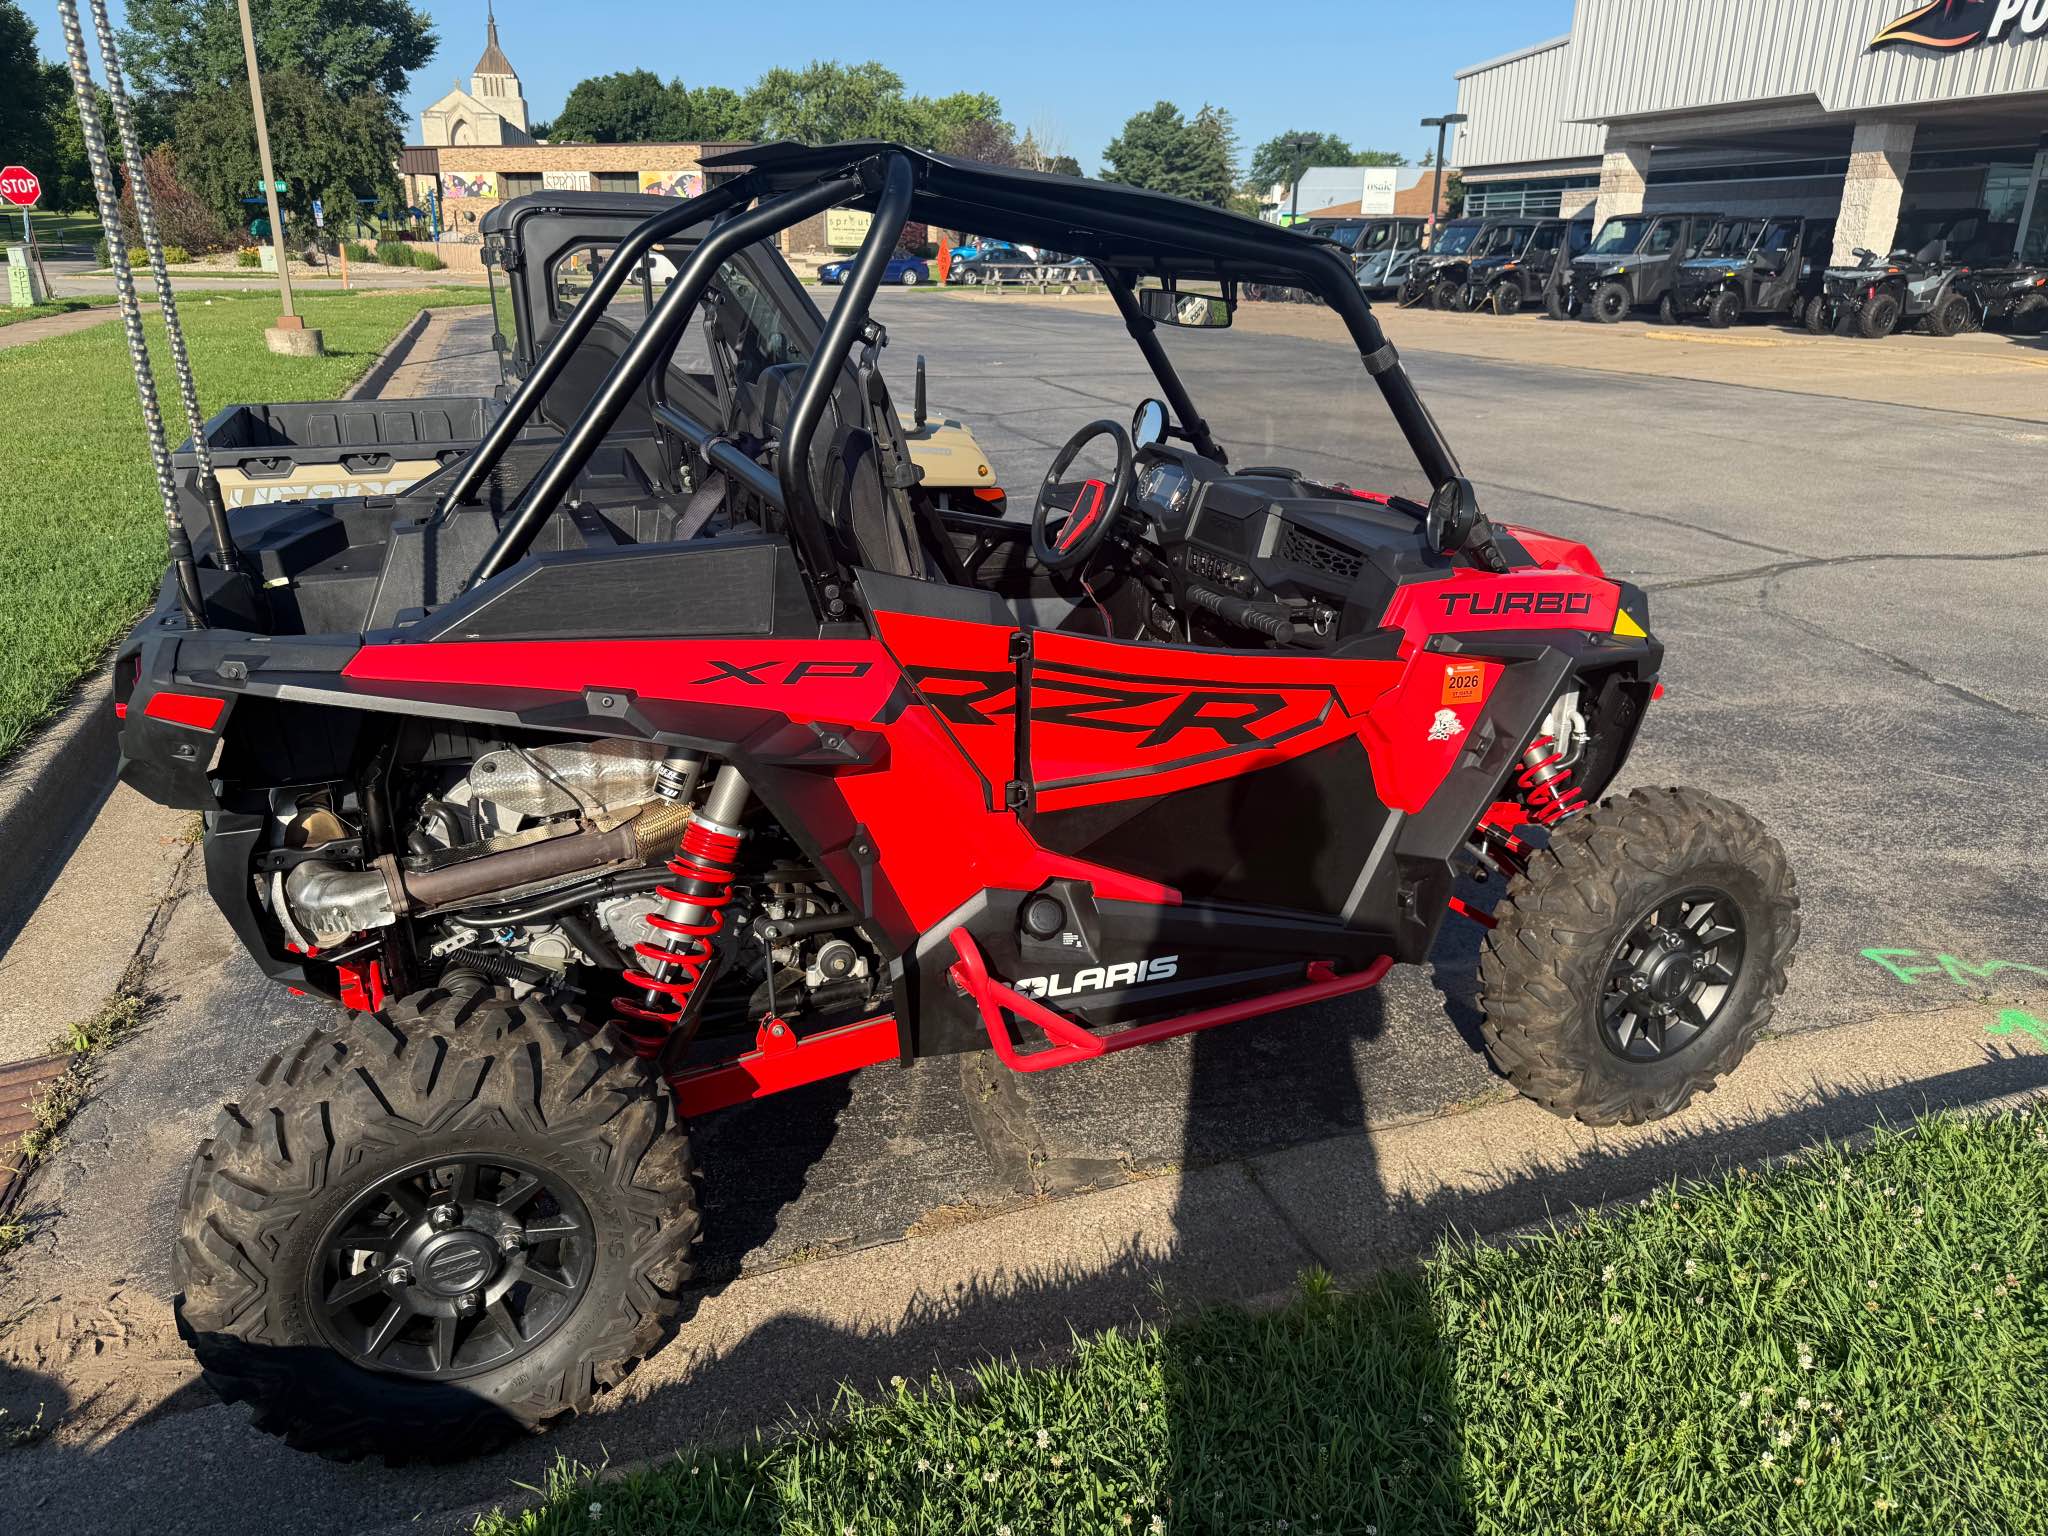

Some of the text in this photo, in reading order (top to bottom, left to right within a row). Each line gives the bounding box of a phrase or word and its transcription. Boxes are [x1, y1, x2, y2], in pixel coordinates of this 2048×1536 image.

[1, 178, 36, 193] STOP
[546, 174, 588, 190] SPROUT
[1439, 592, 1592, 616] TURBO
[688, 660, 874, 685] XP
[1449, 675, 1479, 689] 2026
[903, 664, 1289, 749] RZR
[1001, 955, 1179, 1000] OLARIS
